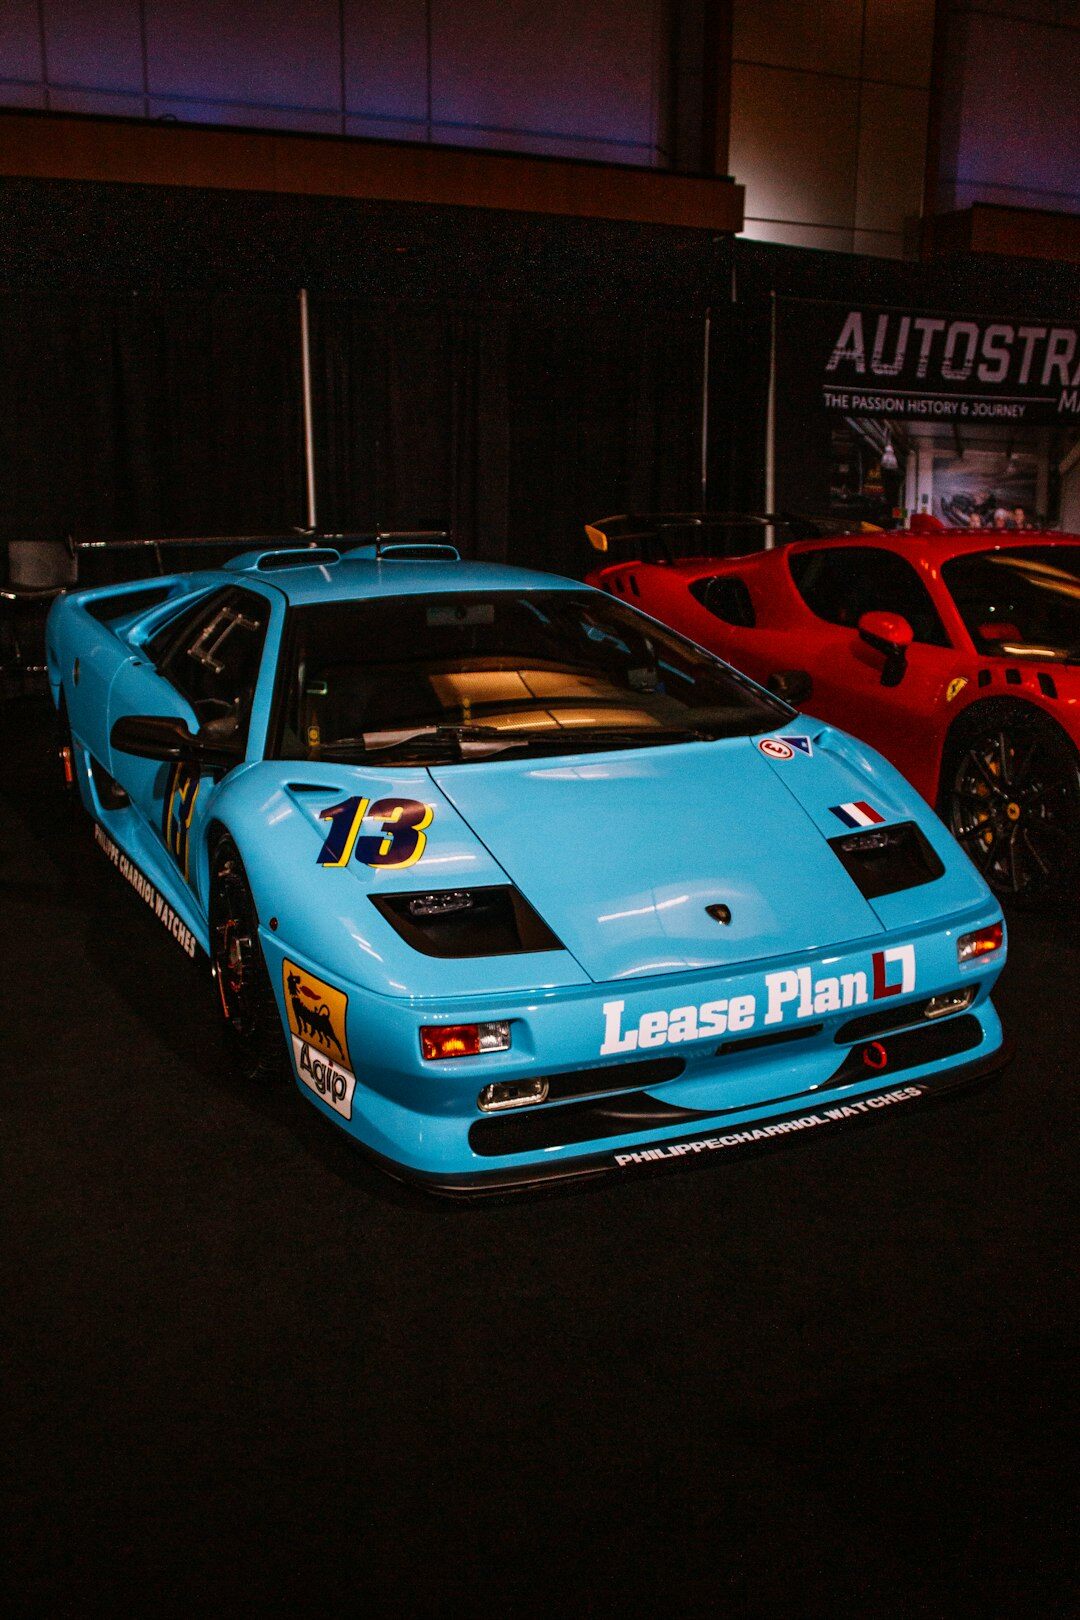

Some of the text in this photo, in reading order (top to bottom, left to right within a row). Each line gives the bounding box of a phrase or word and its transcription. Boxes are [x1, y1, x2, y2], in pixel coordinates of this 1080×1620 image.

[825, 311, 1080, 386] AUTOSTR
[823, 393, 1026, 417] THE PASSION HISTORY & JOURNEY
[1057, 389, 1080, 414] M
[316, 796, 434, 870] 13
[119, 854, 155, 910] CHARRIOL
[155, 893, 196, 958] WATCHES
[300, 1043, 347, 1104] Agip
[823, 1086, 922, 1121] WATCHES
